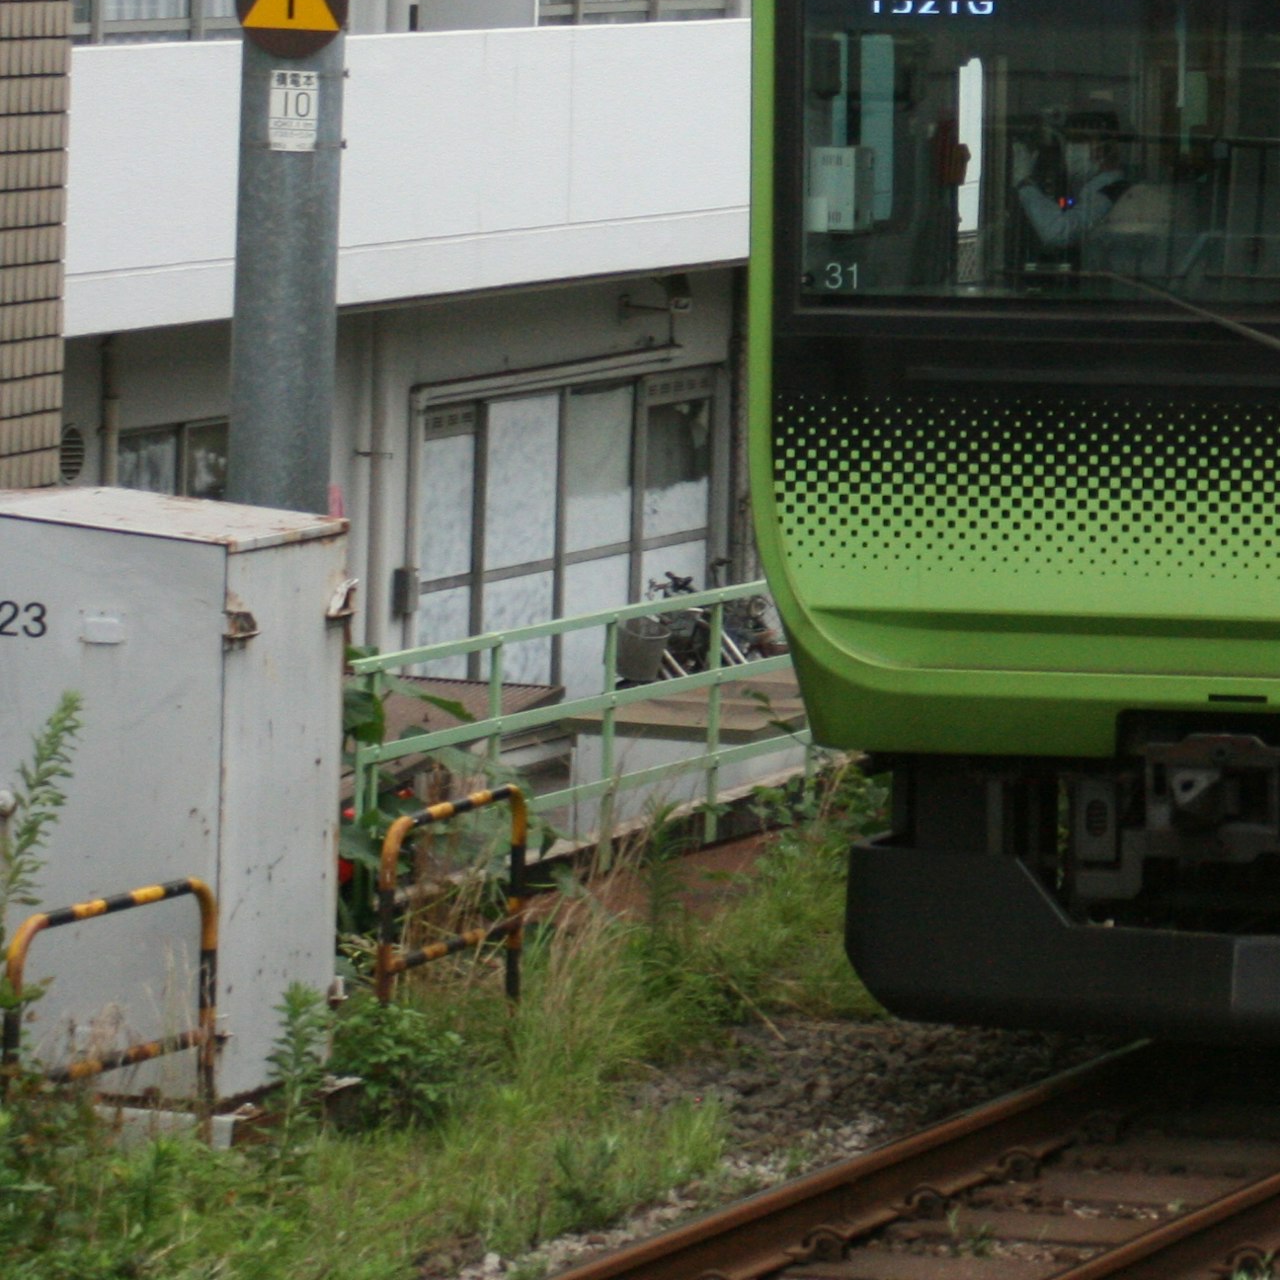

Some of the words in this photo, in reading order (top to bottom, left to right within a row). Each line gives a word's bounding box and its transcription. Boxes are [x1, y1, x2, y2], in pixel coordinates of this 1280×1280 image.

[283, 91, 310, 118] 10
[825, 262, 858, 290] 31
[0, 600, 47, 638] 23
